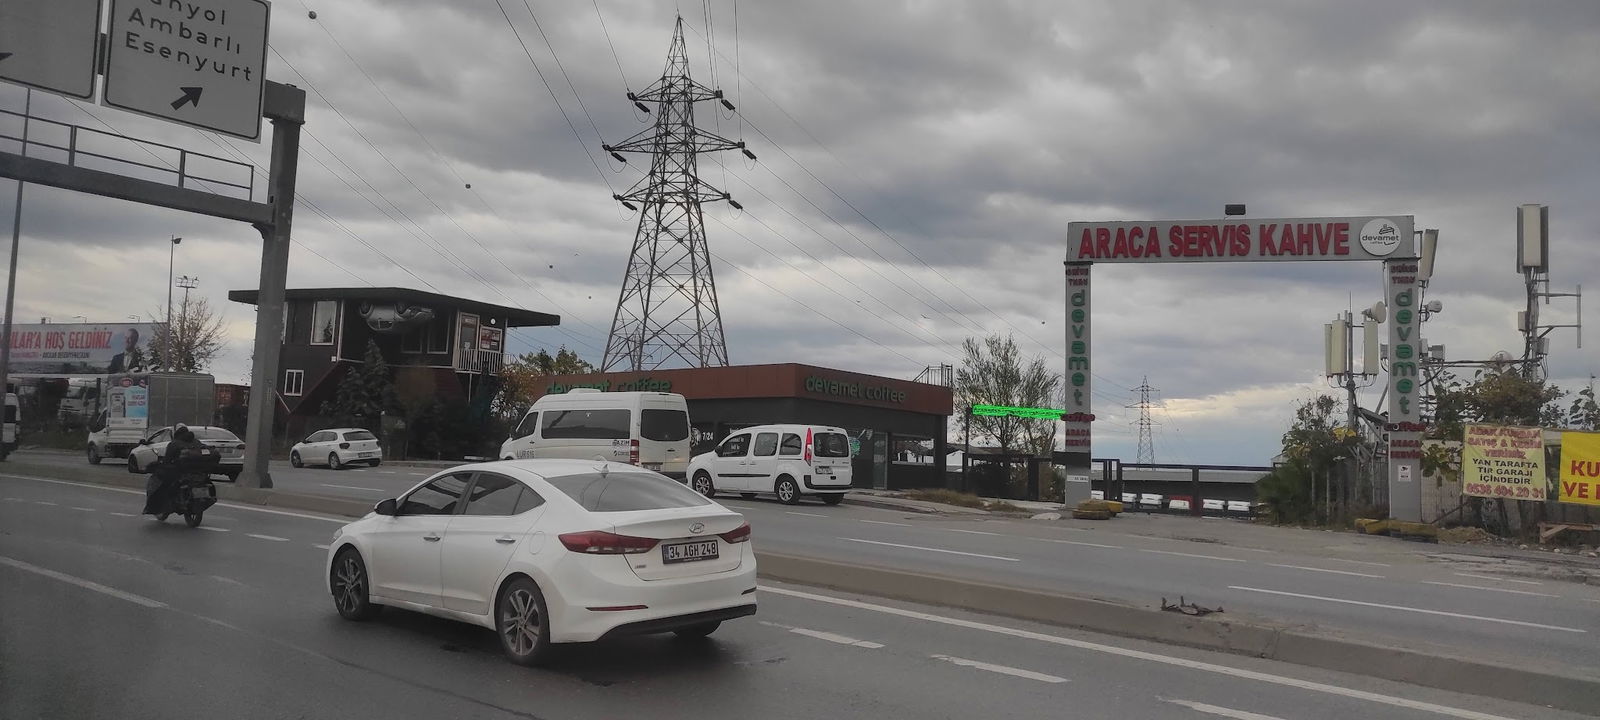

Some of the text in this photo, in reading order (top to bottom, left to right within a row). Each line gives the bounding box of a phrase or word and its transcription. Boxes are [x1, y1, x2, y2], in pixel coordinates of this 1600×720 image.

[128, 8, 240, 54] Ambarlı
[126, 31, 251, 81] Esenyurt
[1078, 226, 1162, 259] ARACA
[1259, 223, 1350, 256] KAHVE
[45, 331, 66, 350] HOŞ
[1069, 289, 1089, 406] devamet
[1394, 288, 1417, 415] devamet
[805, 376, 906, 403] devamet coffee
[1472, 458, 1538, 469] YAN TARAFTA
[1496, 468, 1533, 477] GARAJI
[1480, 474, 1531, 485] İÇİNDEDİR
[1563, 481, 1588, 498] VE
[669, 542, 716, 558] 34 AGH 248
